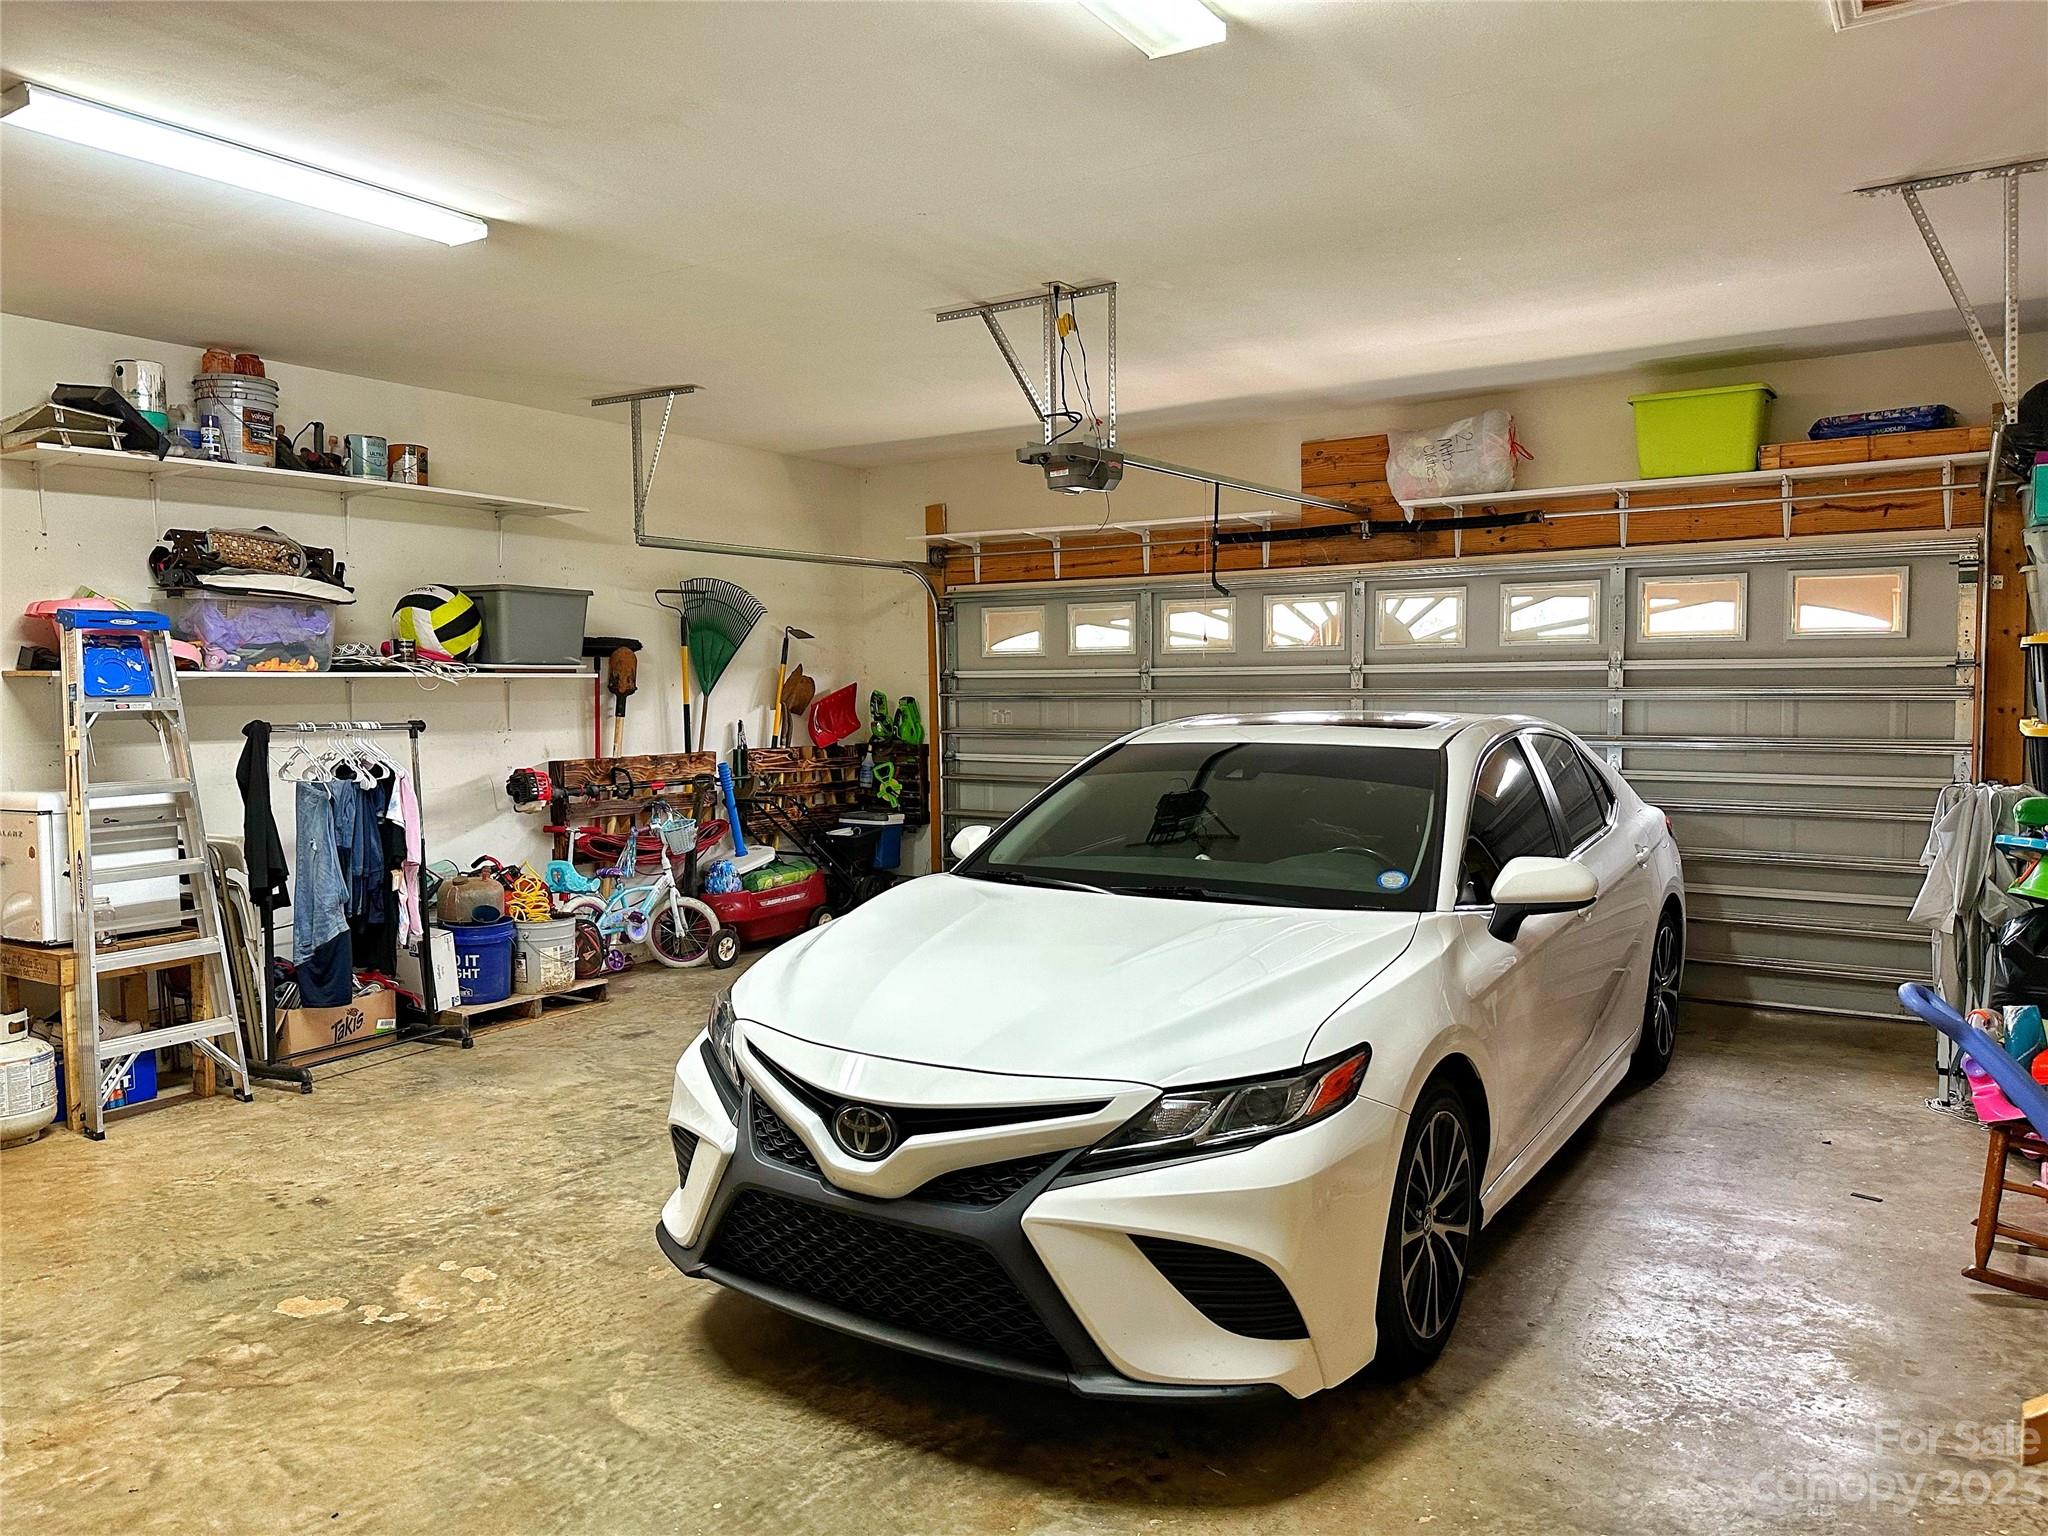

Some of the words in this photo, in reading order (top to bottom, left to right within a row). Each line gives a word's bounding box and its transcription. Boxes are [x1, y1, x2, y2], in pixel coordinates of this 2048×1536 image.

[250, 412, 271, 422] valspar
[1455, 431, 1473, 454] 24
[465, 954, 480, 966] IT
